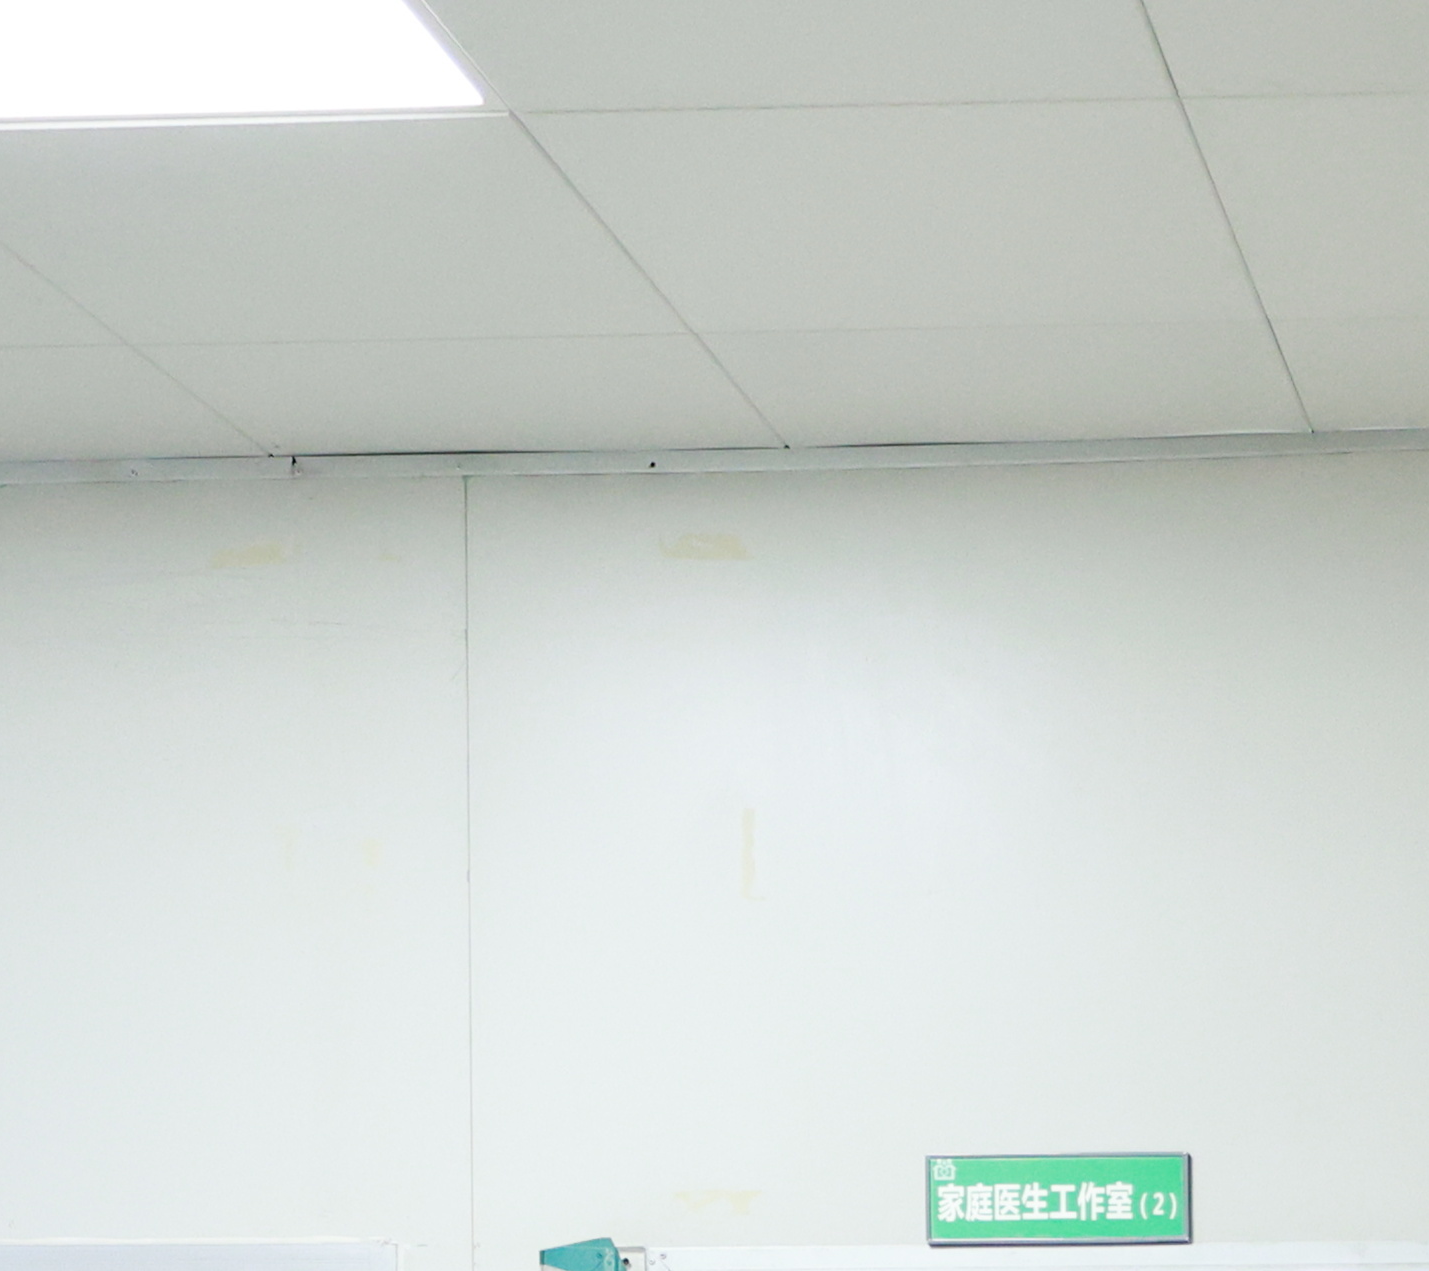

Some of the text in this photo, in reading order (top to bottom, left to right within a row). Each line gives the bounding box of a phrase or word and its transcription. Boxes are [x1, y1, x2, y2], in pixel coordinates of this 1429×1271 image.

[937, 1181, 1177, 1222] 家庭医生工作室(2)
